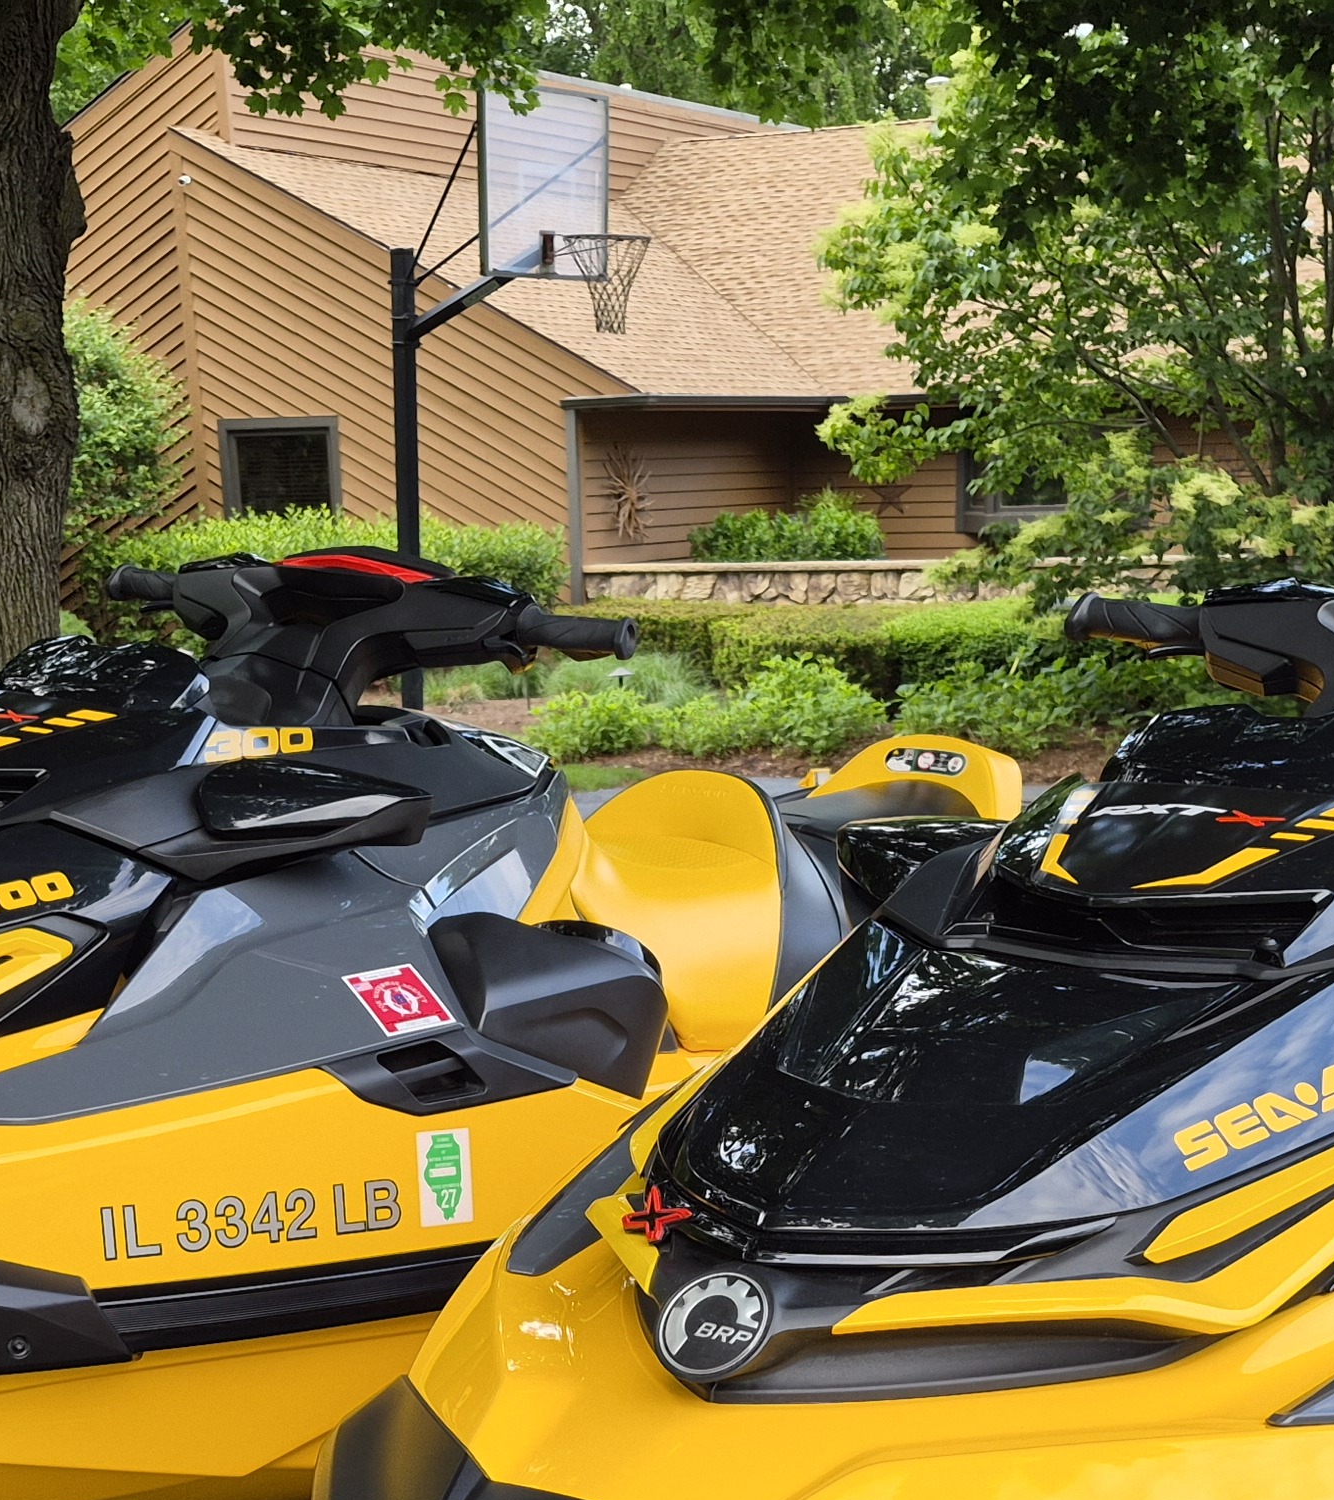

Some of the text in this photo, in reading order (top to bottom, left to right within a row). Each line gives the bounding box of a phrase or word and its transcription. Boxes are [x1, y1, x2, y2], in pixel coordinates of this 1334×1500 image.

[203, 727, 314, 764] 300
[441, 1188, 457, 1209] 27
[100, 1179, 402, 1261] IL 3342 LB
[694, 1321, 753, 1345] BRP
